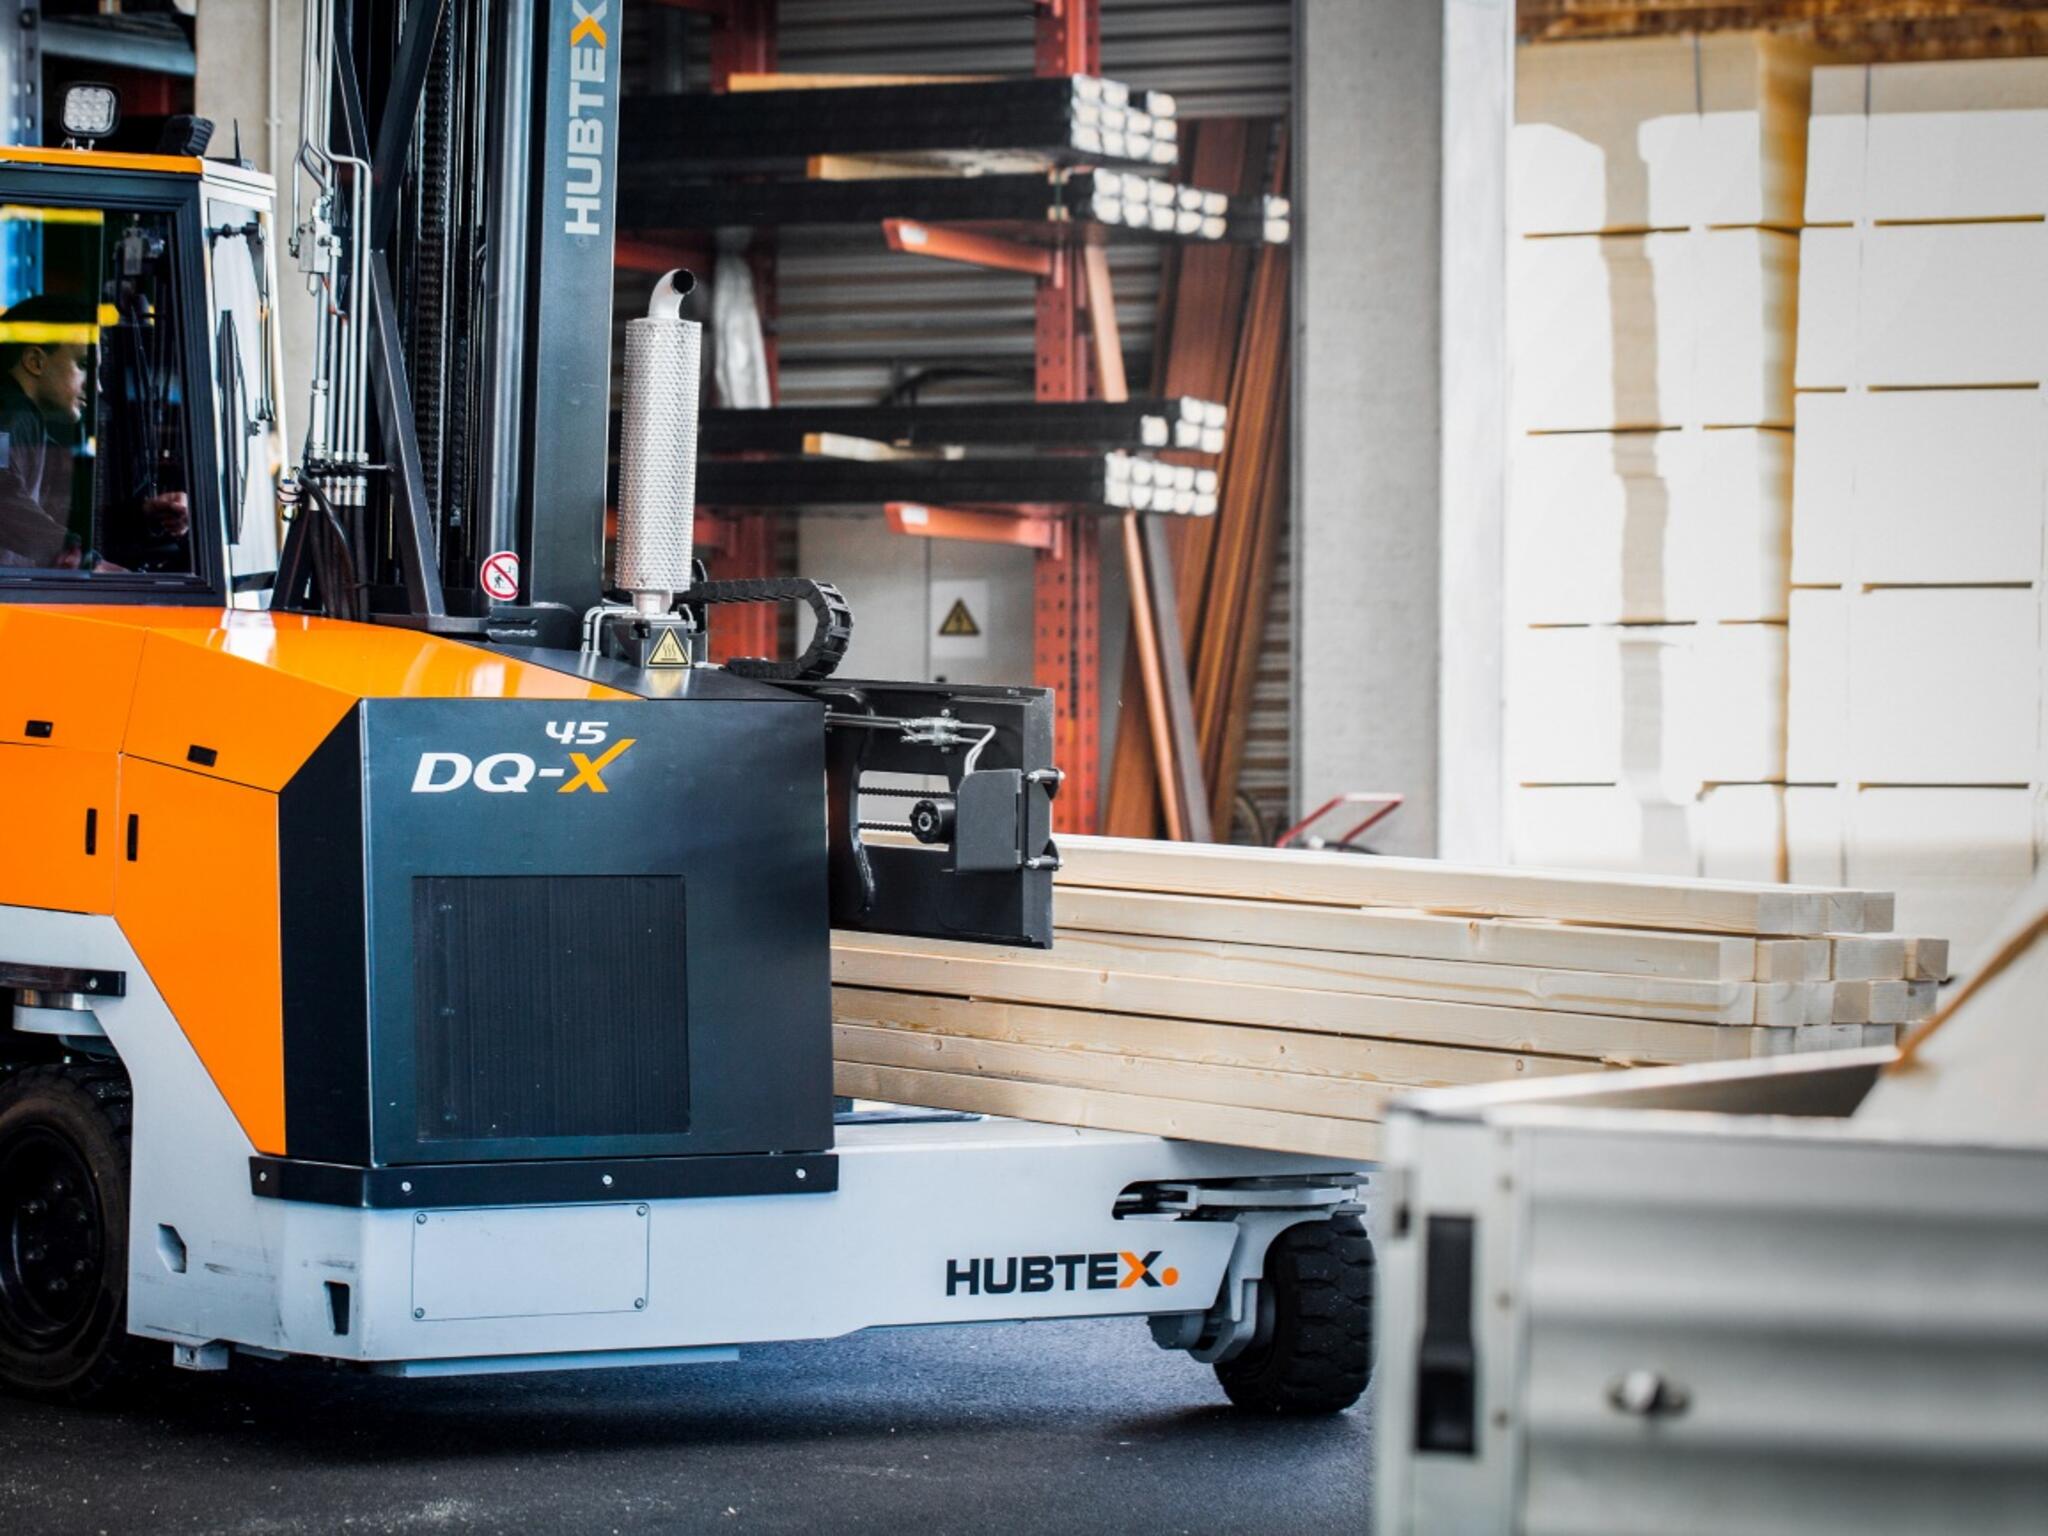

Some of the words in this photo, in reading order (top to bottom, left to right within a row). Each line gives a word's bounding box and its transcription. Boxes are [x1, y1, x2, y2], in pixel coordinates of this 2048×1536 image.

[565, 0, 608, 236] HUBTEX
[545, 721, 609, 745] 45
[411, 738, 638, 793] DQ-X
